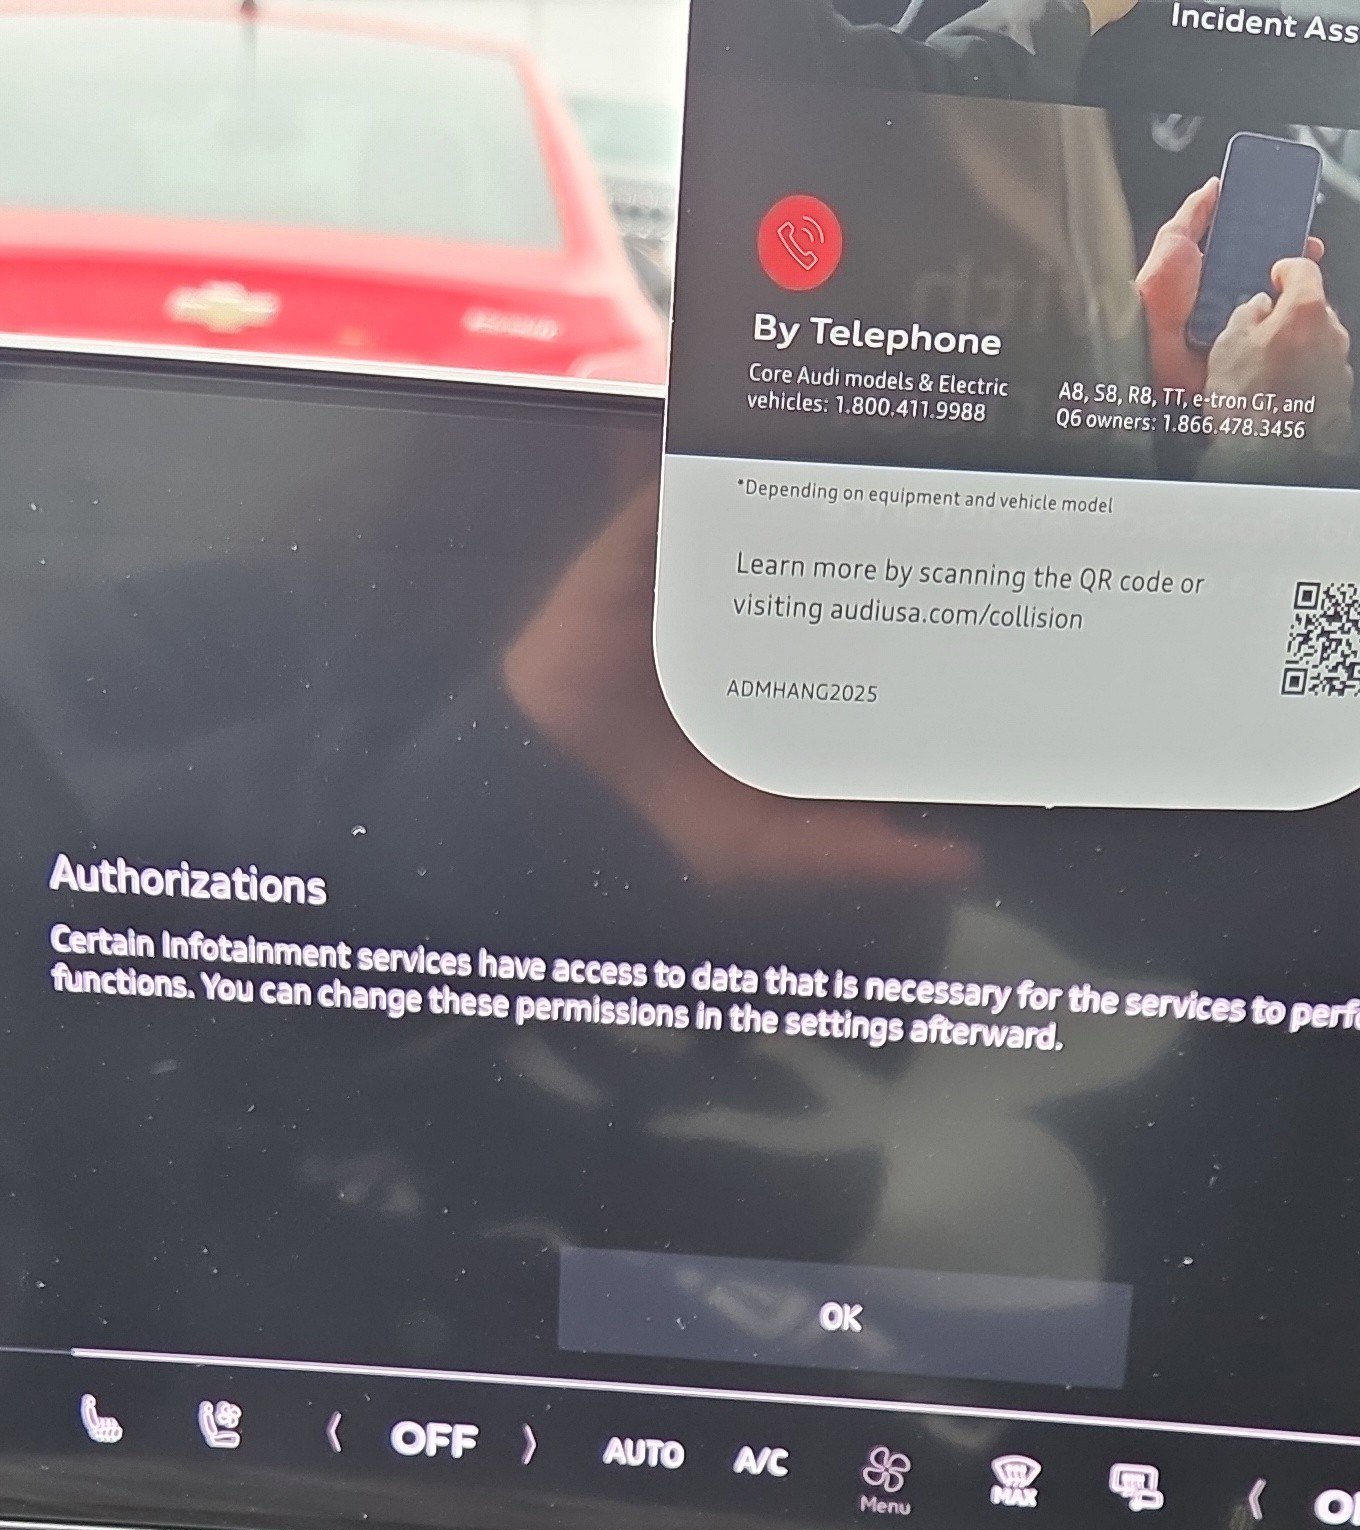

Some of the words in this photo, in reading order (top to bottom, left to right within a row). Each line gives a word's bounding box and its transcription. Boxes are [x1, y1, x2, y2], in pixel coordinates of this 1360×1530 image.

[1172, 1, 1298, 39] Incident
[754, 312, 801, 350] By
[809, 316, 1002, 356] Telephone
[749, 362, 793, 384] Core
[796, 365, 840, 387] Audi
[844, 370, 914, 392] models
[918, 373, 934, 392] &
[939, 373, 1008, 397] Electric
[747, 391, 829, 413] vehicles:
[835, 395, 986, 422] 1.800.411.9988
[1058, 382, 1089, 404] A8,
[1093, 384, 1123, 406] S8,
[1128, 385, 1157, 408] R8,
[1162, 386, 1188, 410] TT,
[1193, 389, 1247, 410] e-tron
[1251, 393, 1279, 414] GT,
[1282, 394, 1315, 414] and
[1056, 409, 1082, 429] Q6
[1085, 413, 1157, 432] owners:
[1163, 413, 1306, 440] 1.866.478.3456
[843, 488, 864, 502] on
[868, 486, 960, 509] equipment
[964, 491, 996, 509] and
[999, 492, 1057, 511] vehicle
[1061, 495, 1113, 514] model
[737, 550, 805, 578] Learn
[813, 560, 877, 581] more
[885, 558, 913, 589] by
[919, 563, 1026, 595] scanning
[1034, 564, 1072, 590] the
[1080, 567, 1112, 594] QR
[1120, 569, 1174, 594] code
[1180, 576, 1205, 595] or
[733, 592, 823, 625] visiting
[830, 597, 1083, 630] audiusa.com/collision
[726, 678, 878, 703] ADMHANG2025
[49, 853, 327, 907] Authorizations
[50, 924, 155, 958] Certain
[162, 930, 352, 969] Infotainment
[356, 944, 473, 978] services
[478, 947, 547, 982] have
[551, 957, 648, 988] access
[653, 959, 686, 990] to
[691, 960, 759, 995] data
[764, 964, 830, 999] that
[833, 968, 859, 1001] is
[865, 977, 1014, 1015] necessary
[1016, 978, 1064, 1012] for
[1067, 982, 1120, 1016] the
[1124, 989, 1247, 1024] services
[1250, 994, 1287, 1027] to
[50, 962, 196, 1000] functions.
[200, 970, 254, 1004] You
[259, 980, 312, 1007] can
[317, 977, 423, 1018] change
[427, 983, 510, 1019] these
[515, 994, 690, 1030] permissions
[695, 1000, 723, 1032] in
[728, 1001, 779, 1035] the
[785, 1008, 904, 1047] settings
[908, 1015, 1064, 1051] afterward.
[819, 1301, 864, 1333] OK
[390, 1420, 480, 1460] OFF
[601, 1436, 686, 1470] AUTO
[733, 1444, 790, 1478] A/C
[859, 1494, 912, 1517] Menu
[989, 1485, 1039, 1509] MAX
